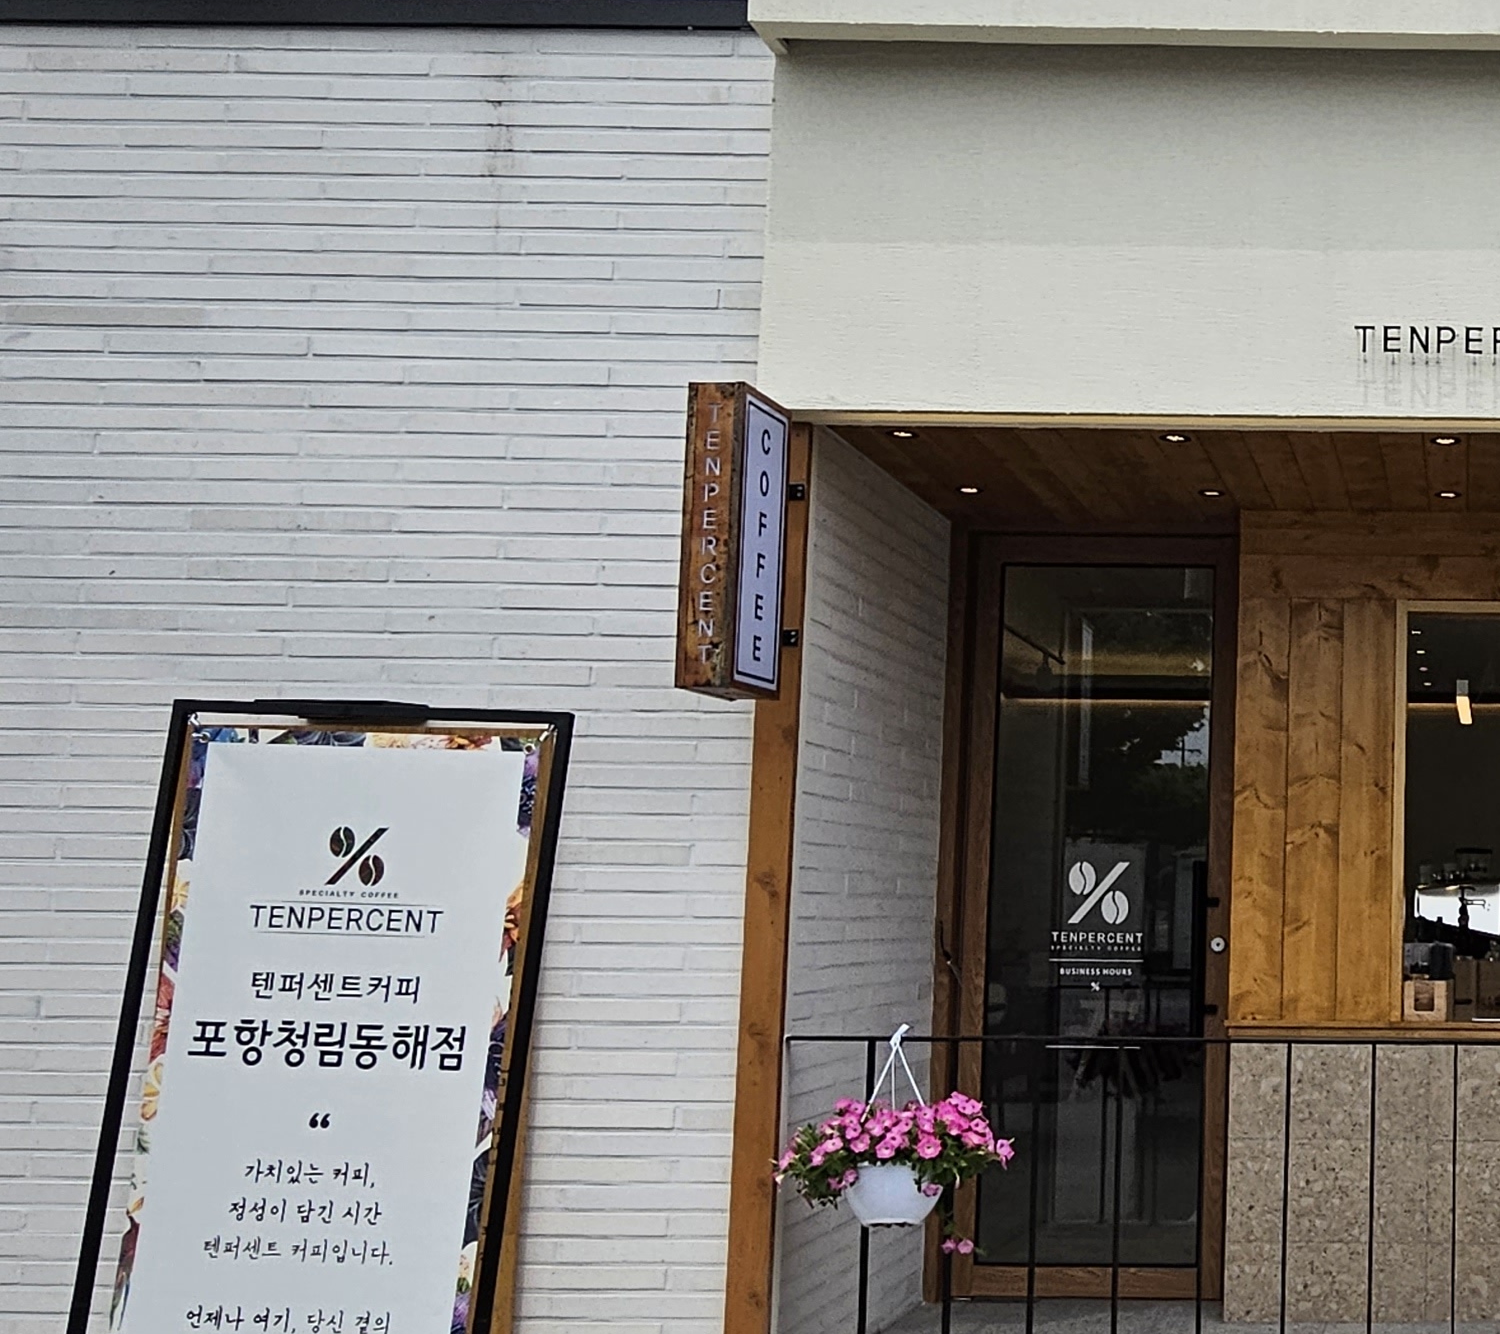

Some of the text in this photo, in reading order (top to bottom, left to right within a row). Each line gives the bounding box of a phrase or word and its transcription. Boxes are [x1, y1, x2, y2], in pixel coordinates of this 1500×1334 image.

[696, 402, 722, 665] TENPERCENT
[752, 428, 772, 663] COFFEE
[299, 889, 399, 899] SPECIALTY COFFEE
[249, 904, 444, 934] TENPERCENT
[1051, 931, 1143, 944] TENPERCENT
[1060, 967, 1133, 976] BUSINESS HOURS
[250, 970, 421, 1004] 텐퍼센트커피
[186, 1019, 467, 1072] 포항청림동해점
[244, 1158, 376, 1188] 가치있는 커피,
[228, 1196, 382, 1226] 정성이 담긴 시간
[203, 1235, 394, 1266] 텐퍼센트 커피입니다.
[186, 1304, 245, 1331] 언제나
[253, 1307, 296, 1334] 여기,
[307, 1308, 344, 1334] 당신
